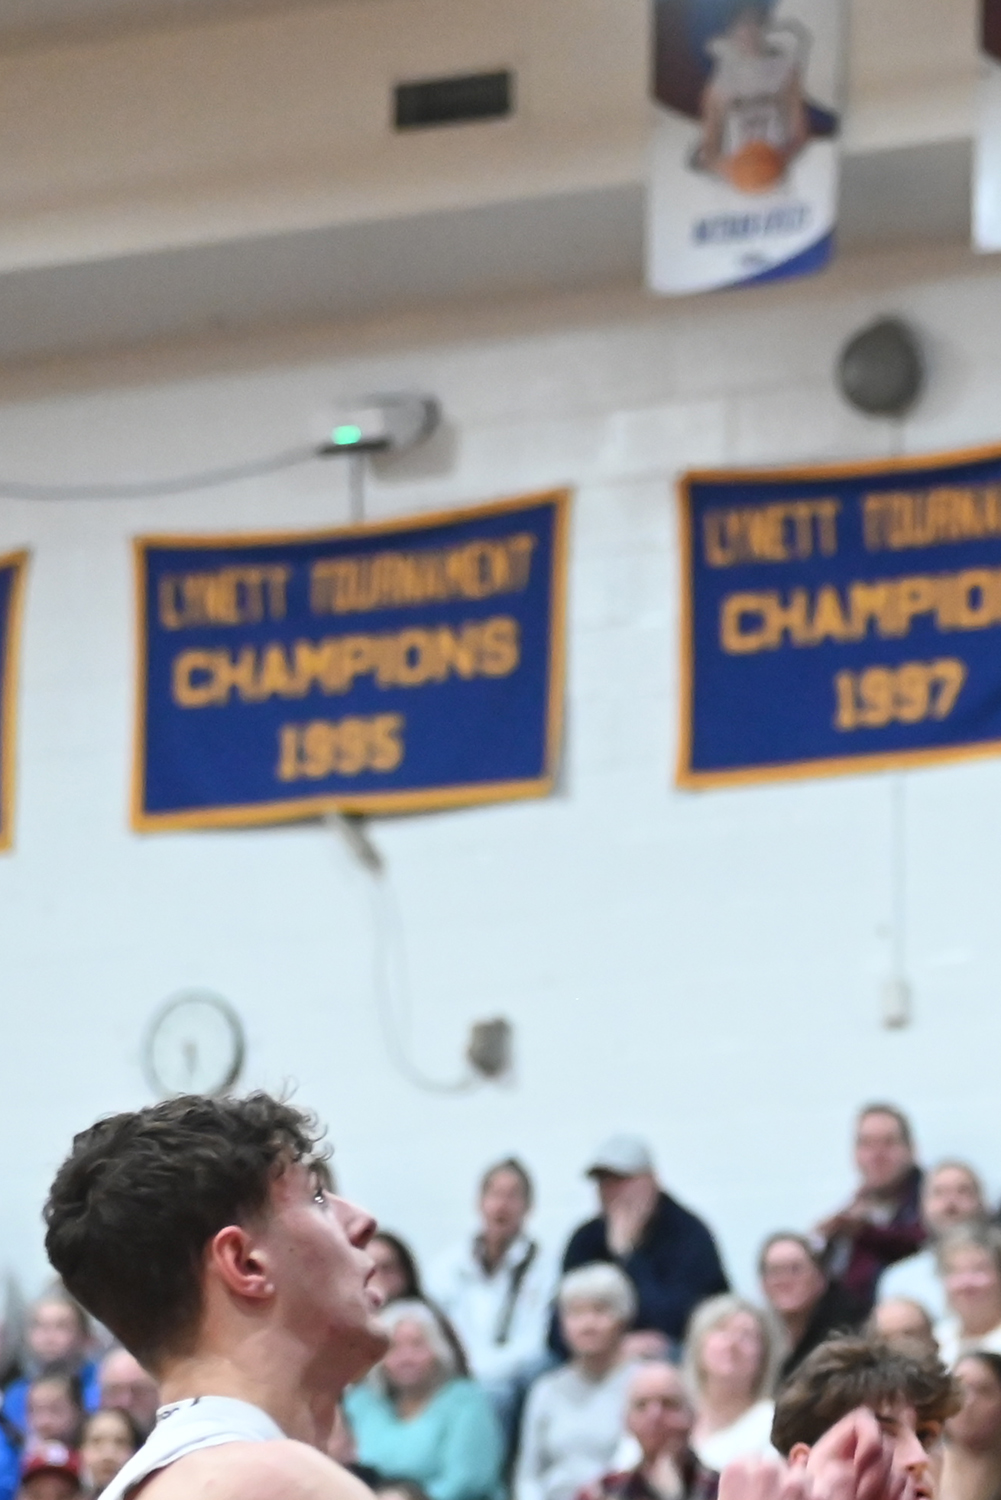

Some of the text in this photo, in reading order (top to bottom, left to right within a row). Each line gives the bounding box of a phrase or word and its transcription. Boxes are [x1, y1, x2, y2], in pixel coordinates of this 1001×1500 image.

[704, 497, 841, 567] LYNETT
[158, 532, 539, 630] LYNETT TOURNAMENT
[171, 616, 519, 708] CHAMPIONS
[834, 656, 967, 731] 1997
[276, 713, 404, 781] 1995
